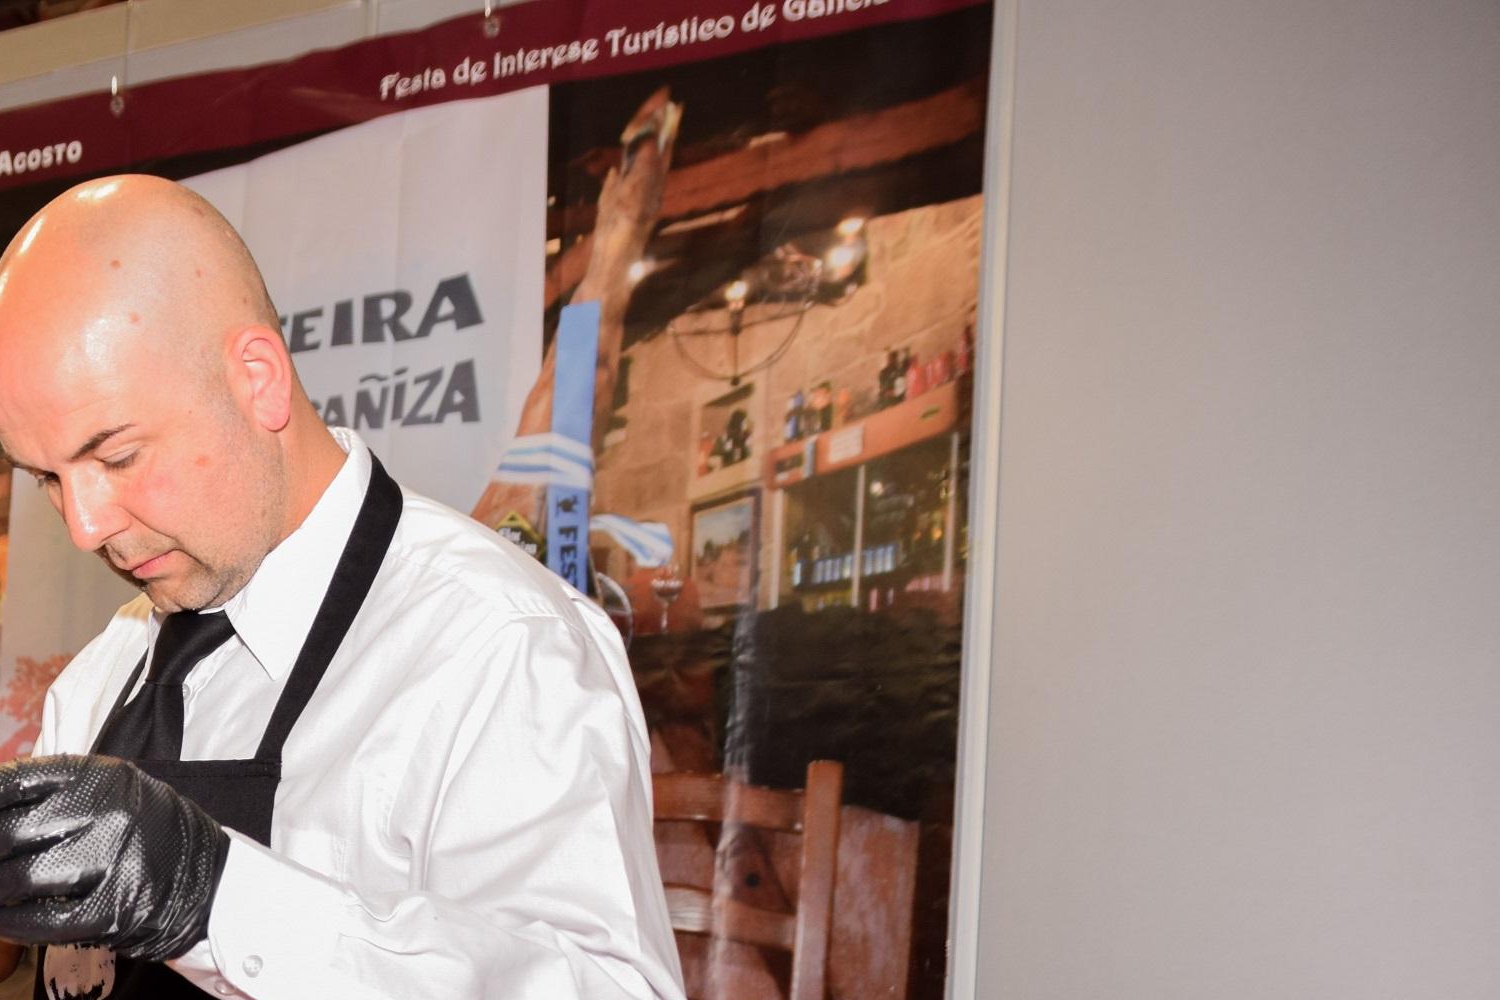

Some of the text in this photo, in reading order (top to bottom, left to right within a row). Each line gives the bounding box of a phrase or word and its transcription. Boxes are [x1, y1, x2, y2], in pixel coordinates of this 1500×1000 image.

[380, 68, 446, 100] Festa
[453, 56, 487, 85] de
[493, 38, 599, 79] Interese
[604, 15, 735, 57] Turístico
[741, 2, 777, 32] de
[280, 271, 484, 353] EIRA
[311, 358, 480, 430] AÑIZA
[559, 525, 579, 588] FES
